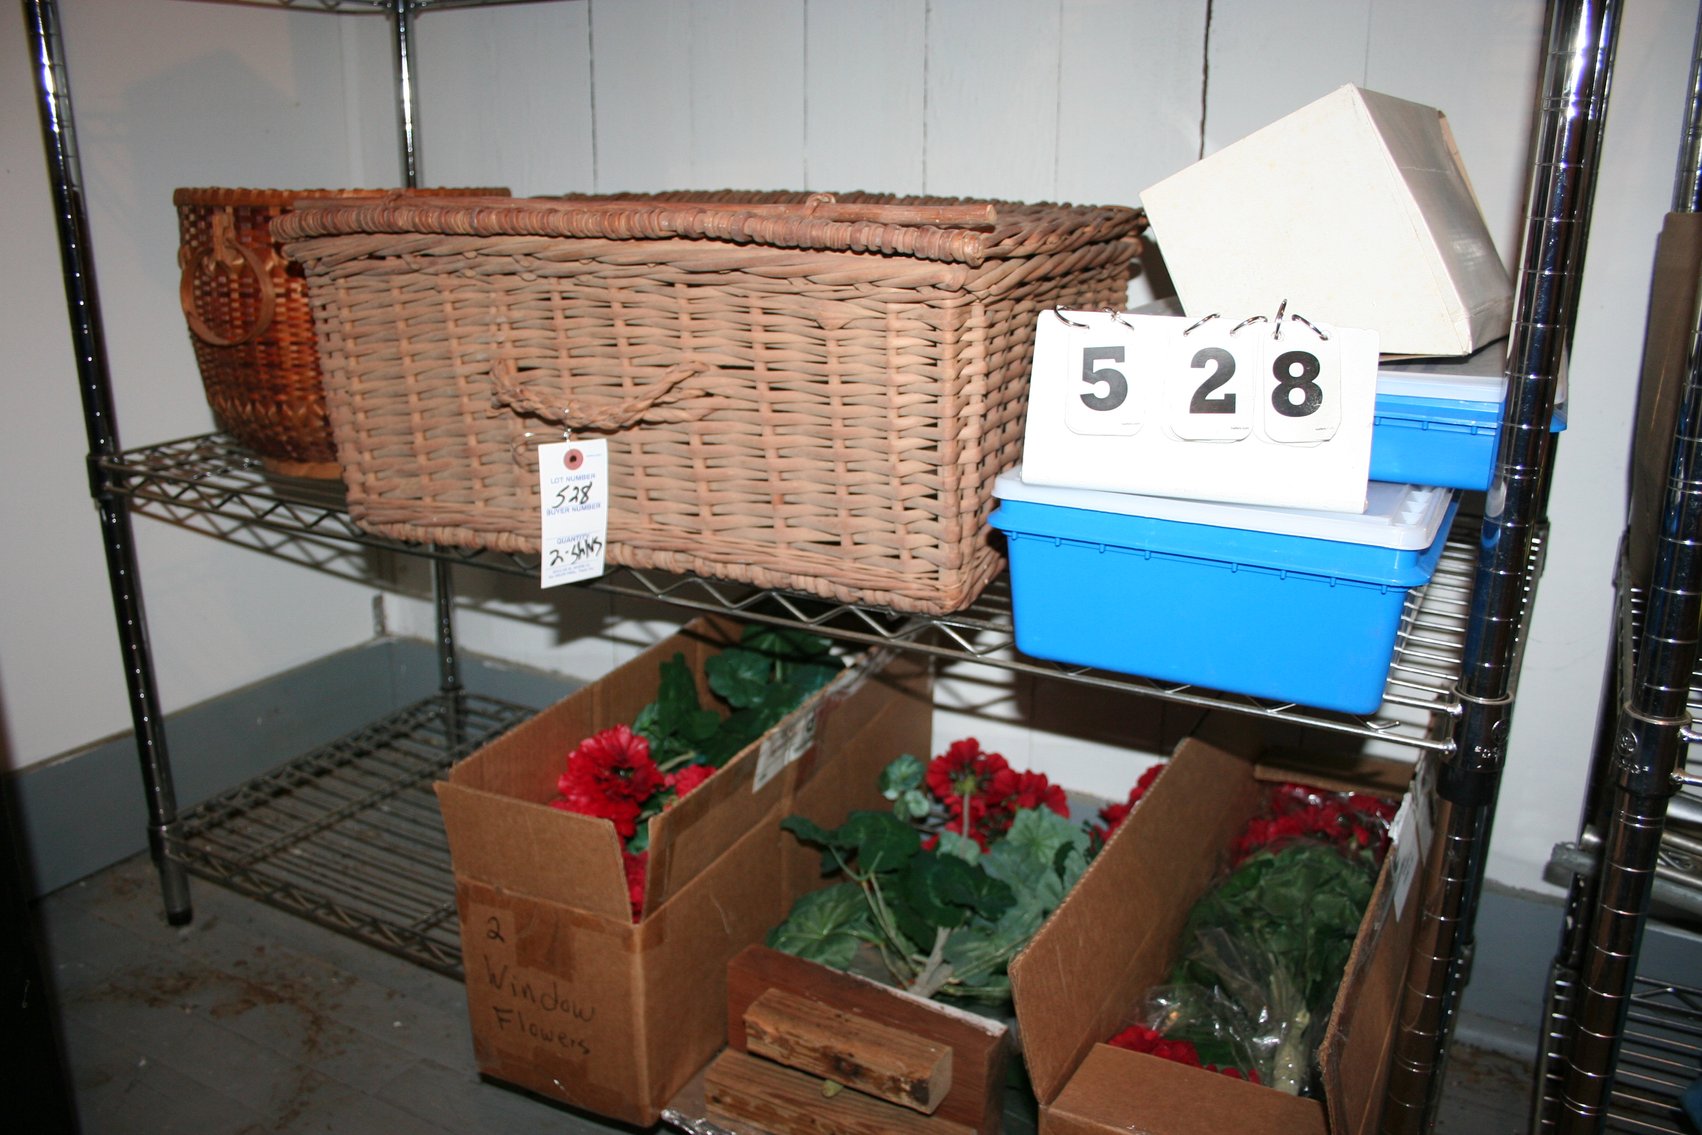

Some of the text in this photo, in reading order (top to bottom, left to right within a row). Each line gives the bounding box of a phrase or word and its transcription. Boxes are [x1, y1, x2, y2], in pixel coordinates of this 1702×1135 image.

[550, 473, 596, 484] LOT NUMBER
[552, 481, 592, 509] 528
[546, 503, 601, 516] BUYER NUMBER
[556, 534, 590, 545] QUANTITY
[486, 916, 505, 943] 2
[484, 954, 596, 1023] Window
[492, 1006, 591, 1055] Flowers
